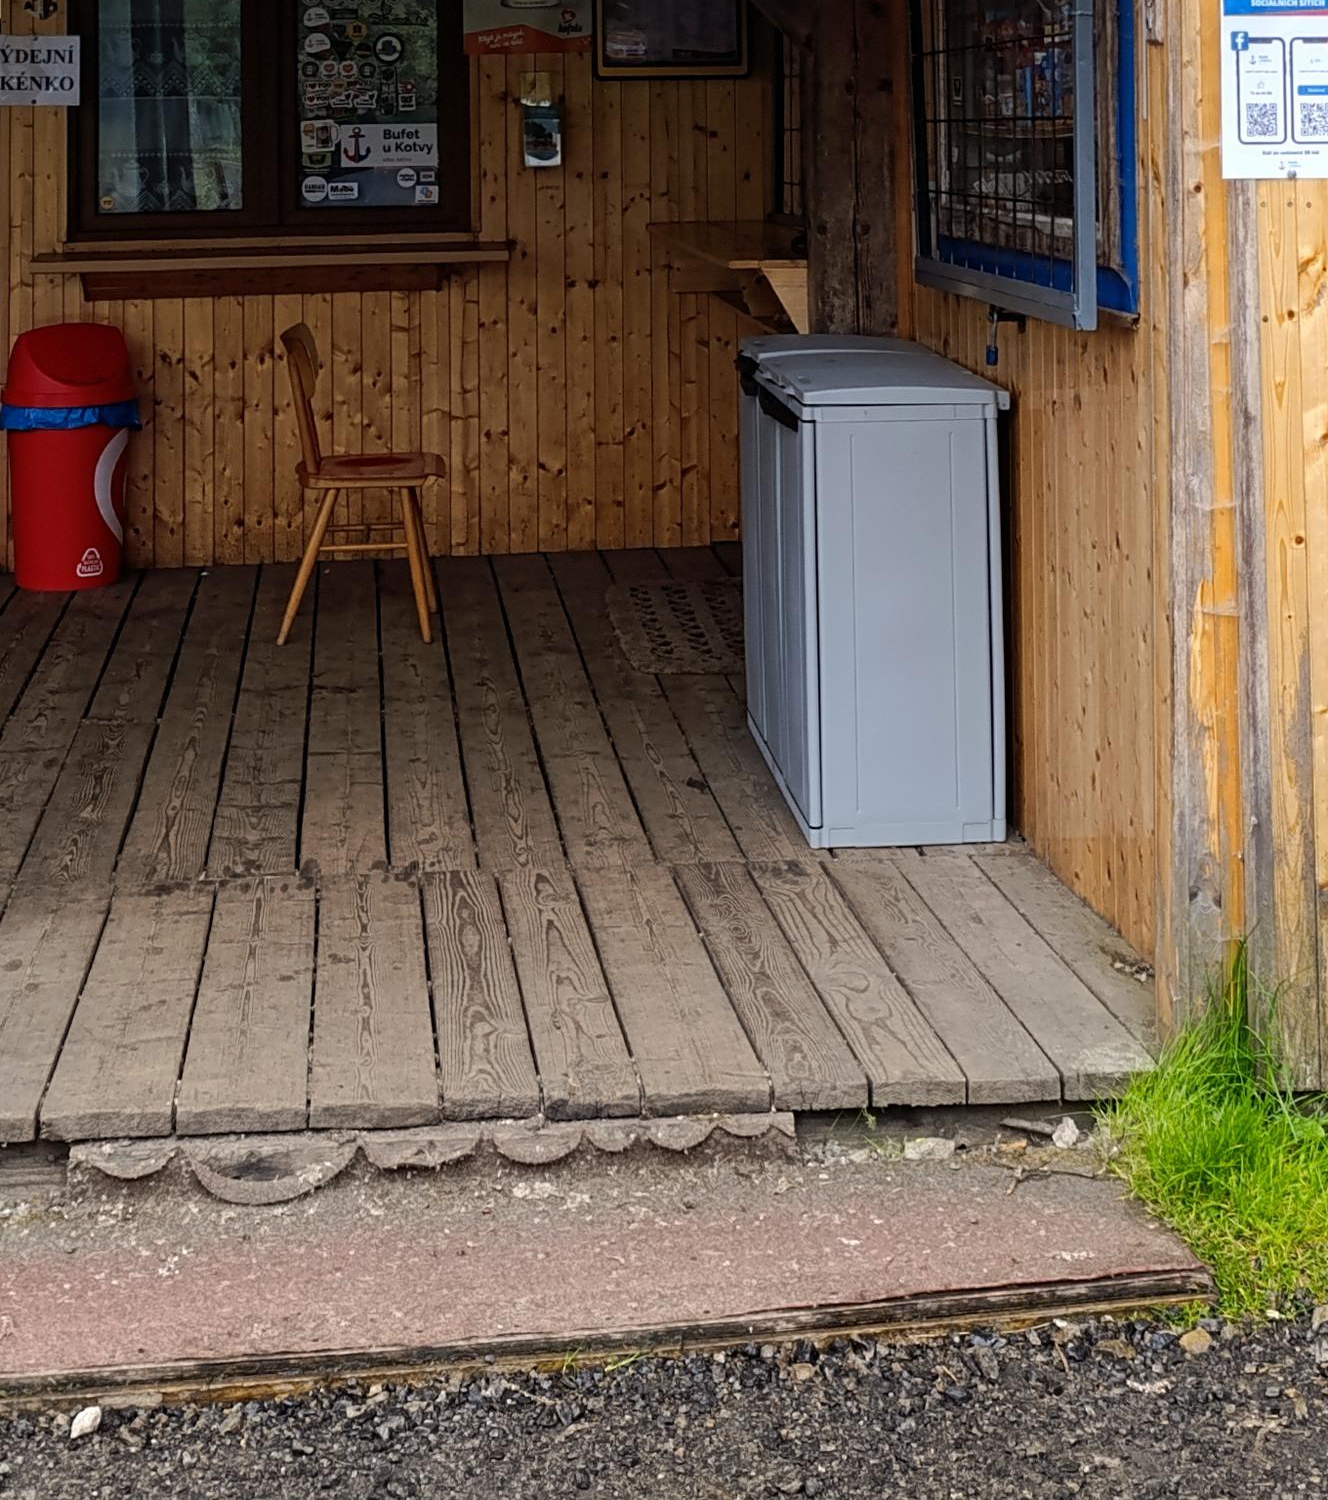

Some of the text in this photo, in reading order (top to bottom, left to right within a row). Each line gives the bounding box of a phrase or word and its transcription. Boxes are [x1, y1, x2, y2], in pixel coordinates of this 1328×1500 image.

[383, 128, 420, 140] Bufet
[383, 142, 433, 155] u Kotvy
